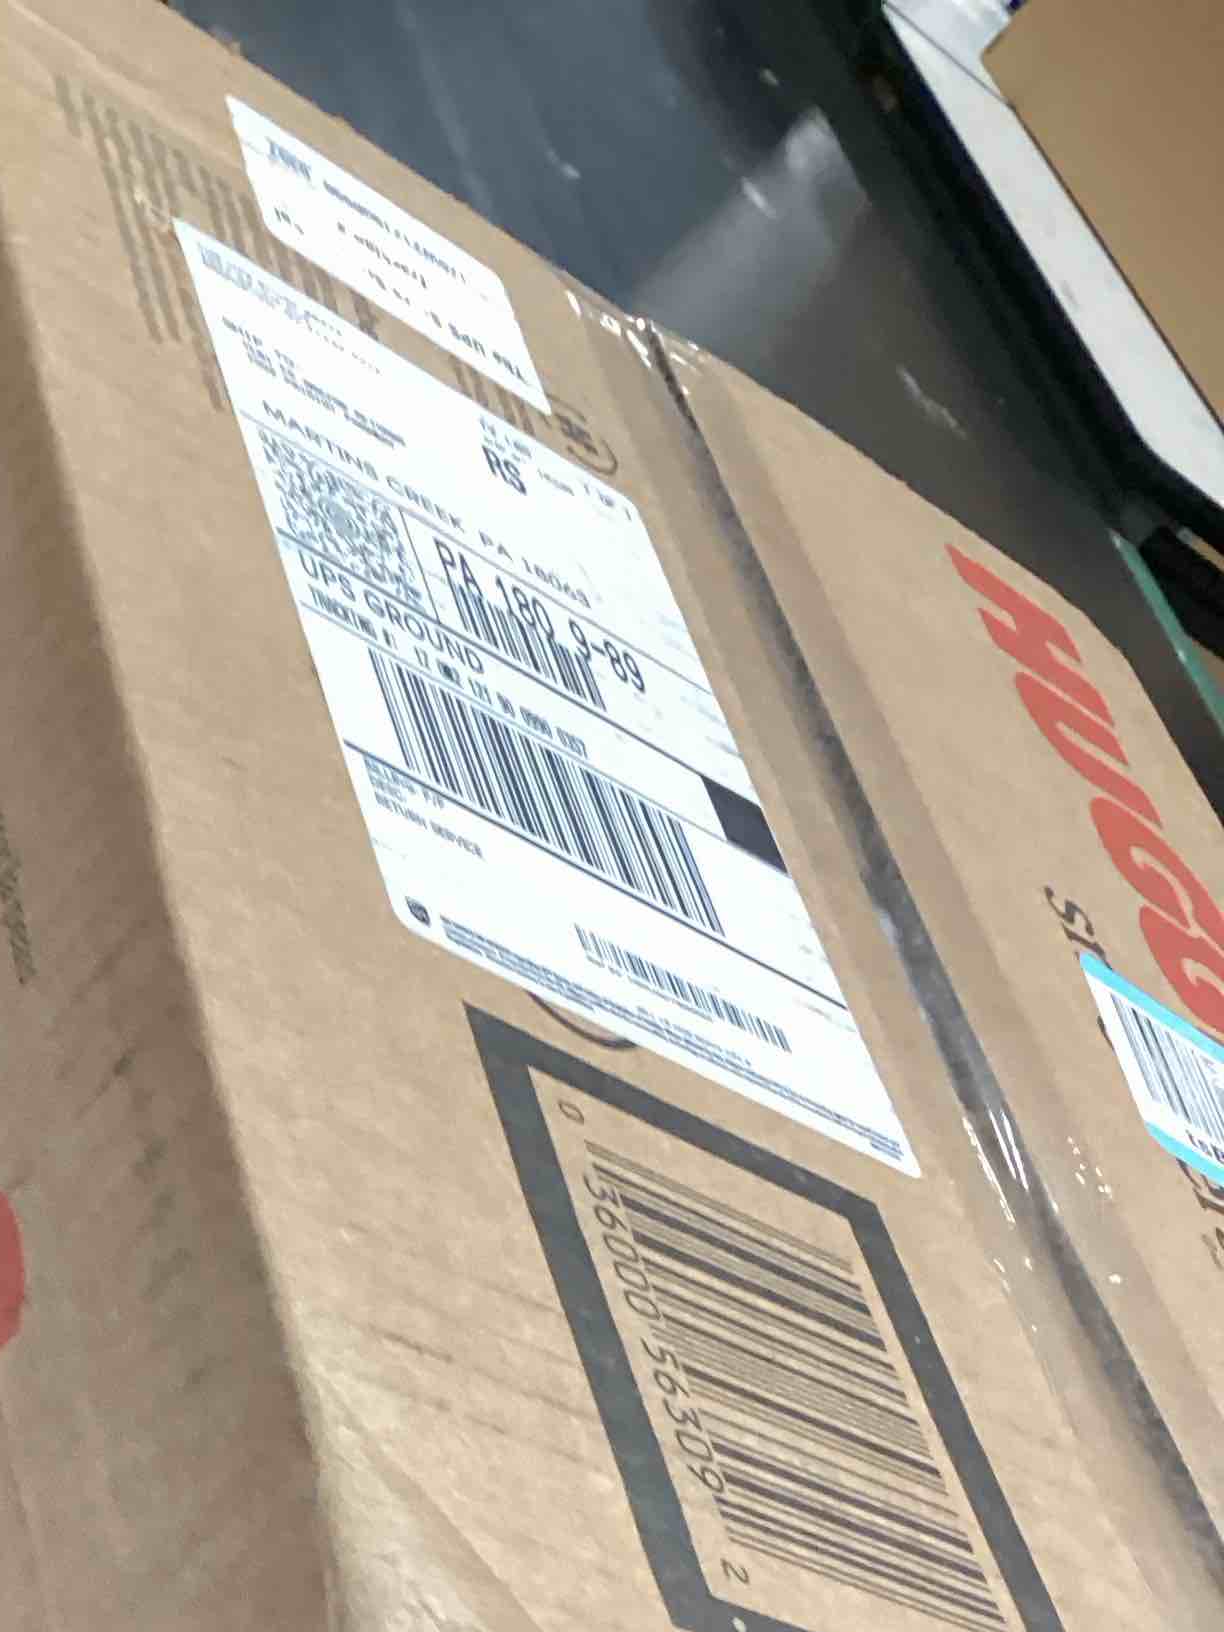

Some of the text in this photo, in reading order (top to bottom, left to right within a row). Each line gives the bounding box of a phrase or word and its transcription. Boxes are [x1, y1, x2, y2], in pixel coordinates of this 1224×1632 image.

[260, 396, 379, 483] MARTINS
[383, 471, 466, 535] CREEK
[476, 526, 514, 564] PA
[481, 445, 527, 496] RS
[297, 549, 488, 679] UPS GROUND
[433, 536, 649, 696] PA 180 9-89
[558, 1099, 750, 1586] 0 36000 56309 2
